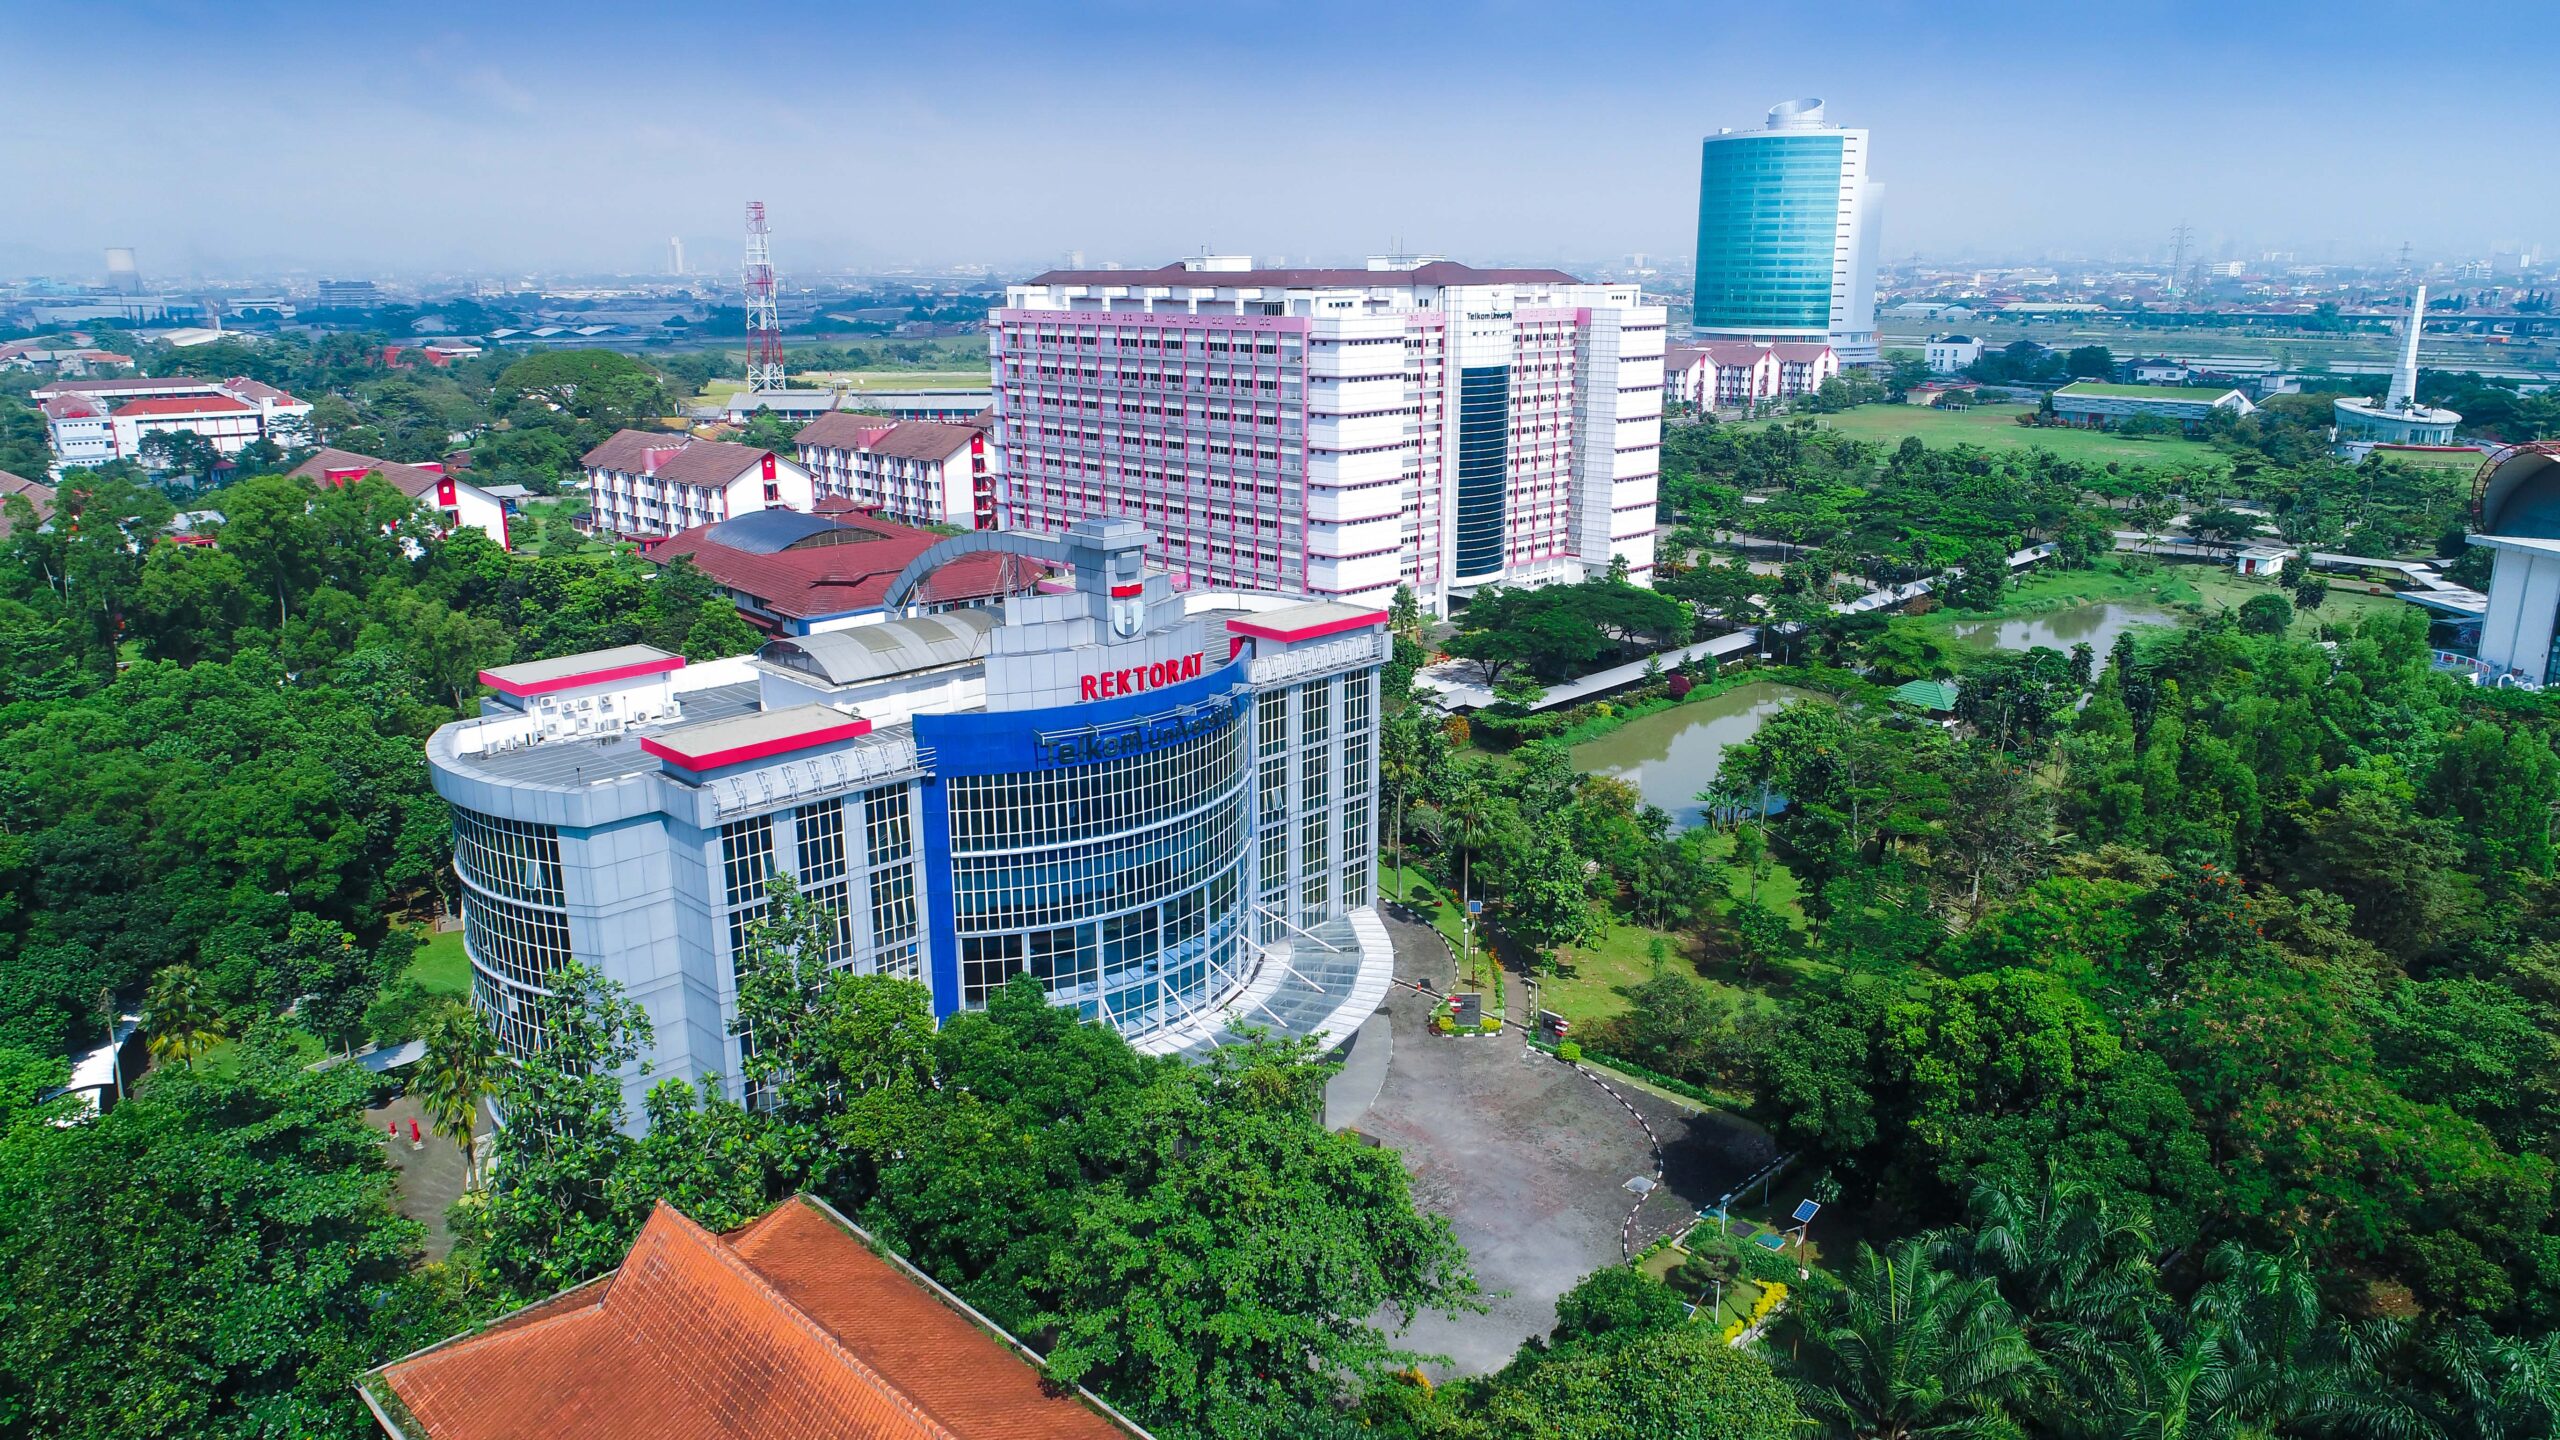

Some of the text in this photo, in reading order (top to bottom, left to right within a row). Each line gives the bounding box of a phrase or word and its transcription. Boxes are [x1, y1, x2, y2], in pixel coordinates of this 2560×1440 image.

[1466, 312, 1490, 320] Telkom
[1081, 652, 1204, 701] REKTORAT
[1043, 731, 1141, 767] Telkom
